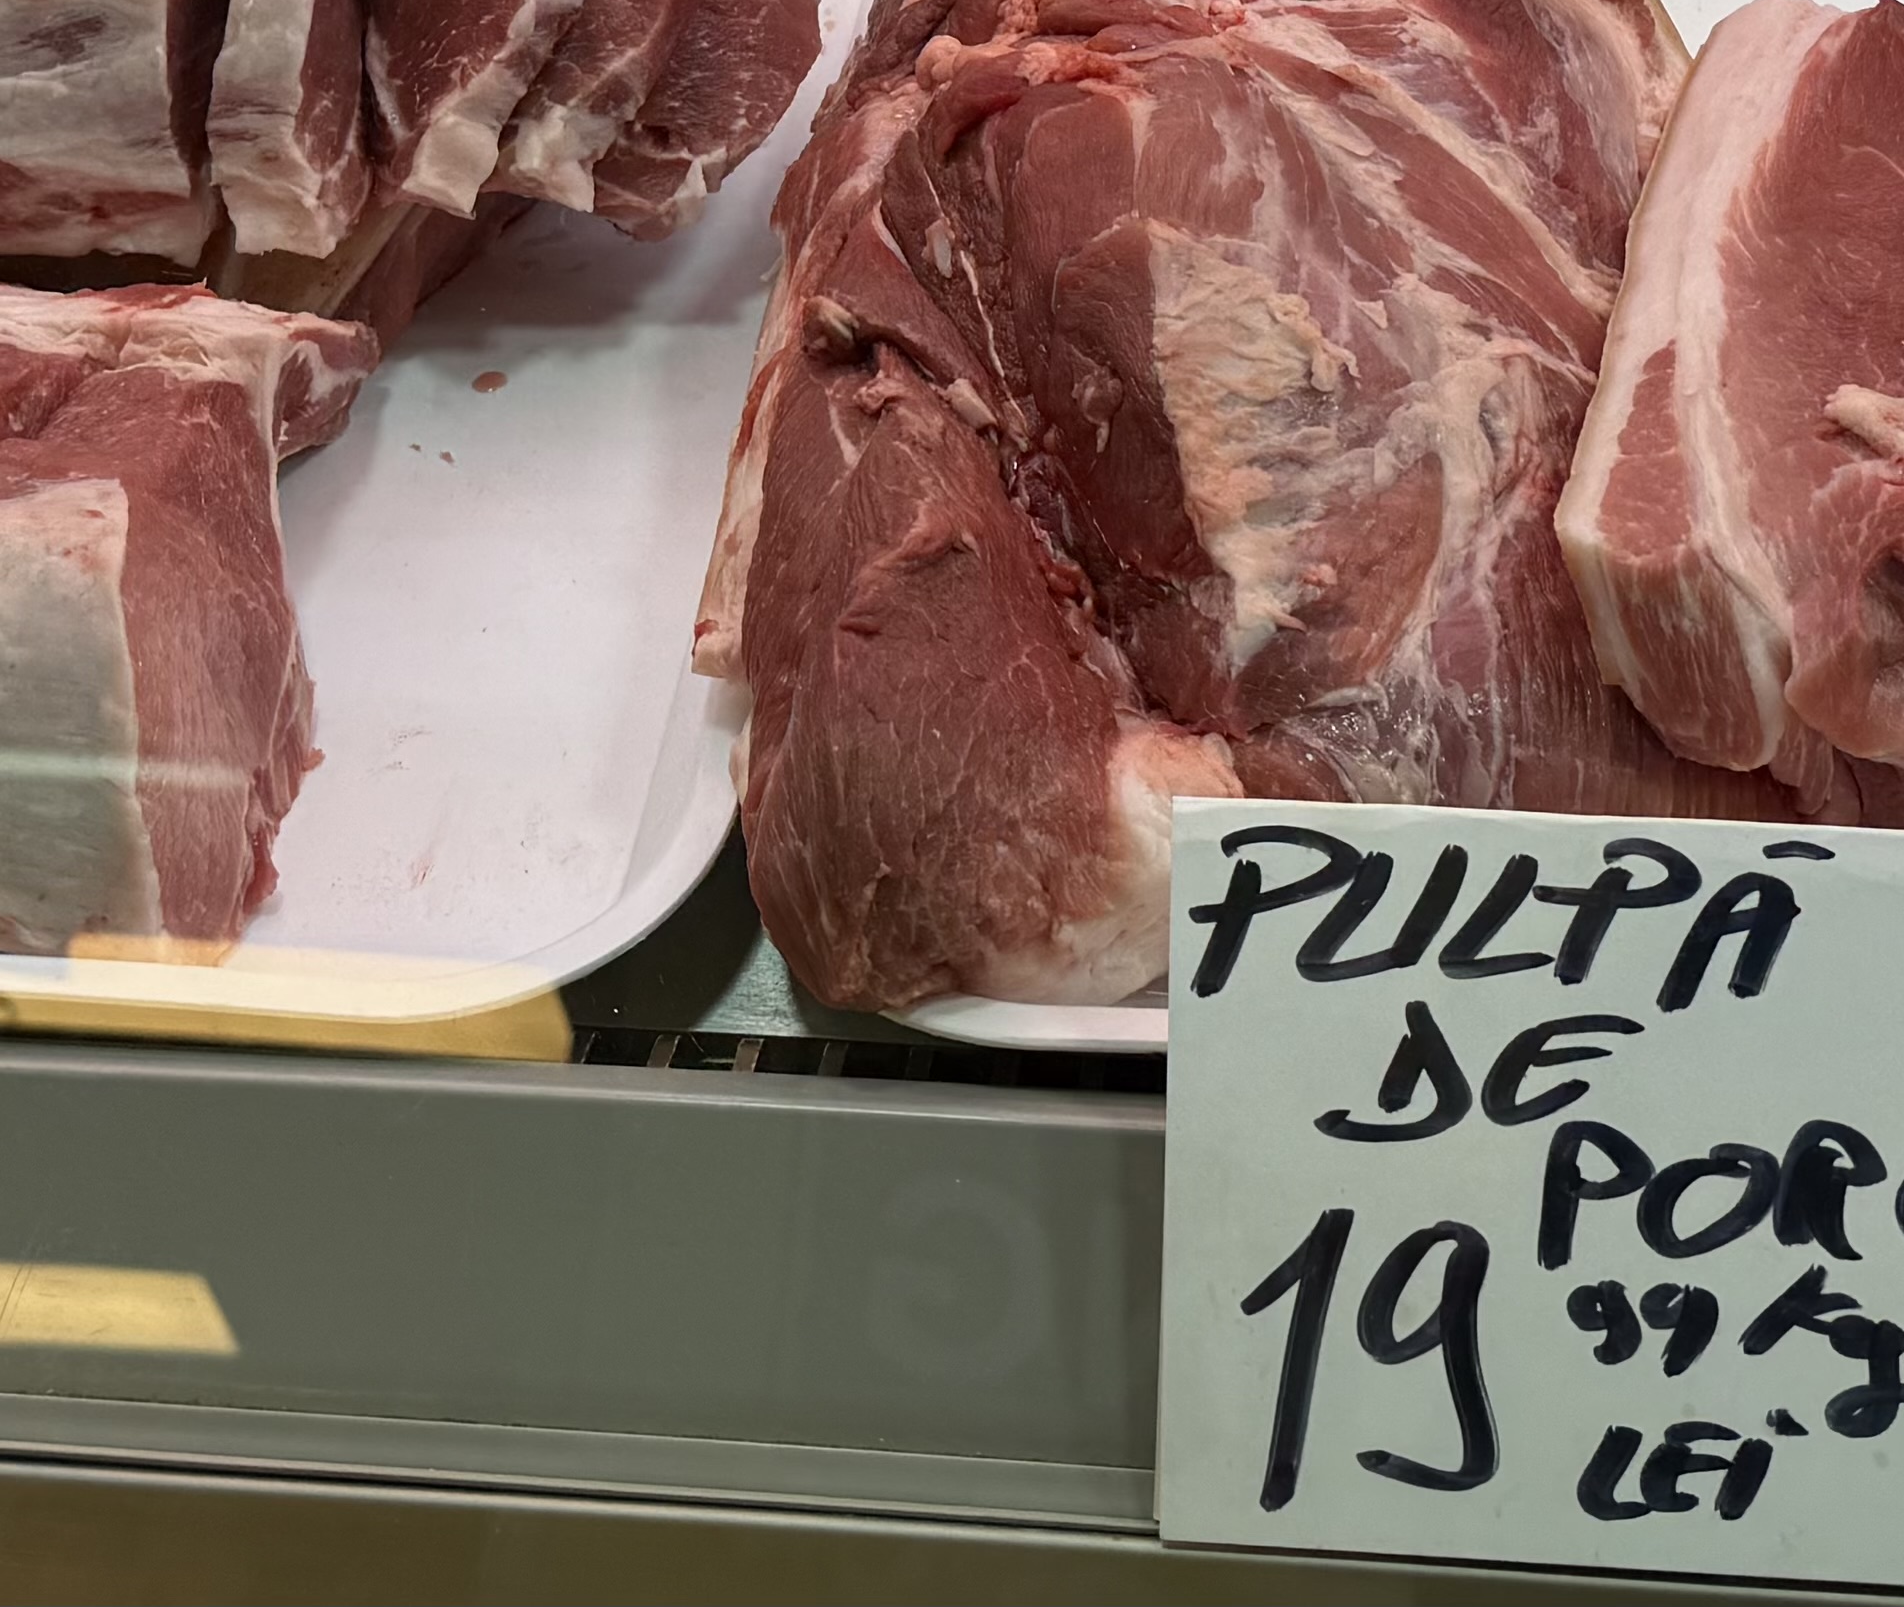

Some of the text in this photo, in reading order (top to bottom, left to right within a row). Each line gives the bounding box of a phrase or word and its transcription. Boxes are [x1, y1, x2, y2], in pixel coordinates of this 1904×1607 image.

[1314, 1000, 1646, 1142] DE
[1240, 1208, 1500, 1513] 19
[1566, 1280, 1719, 1377] 99
[1576, 1407, 1809, 1522] LEI
